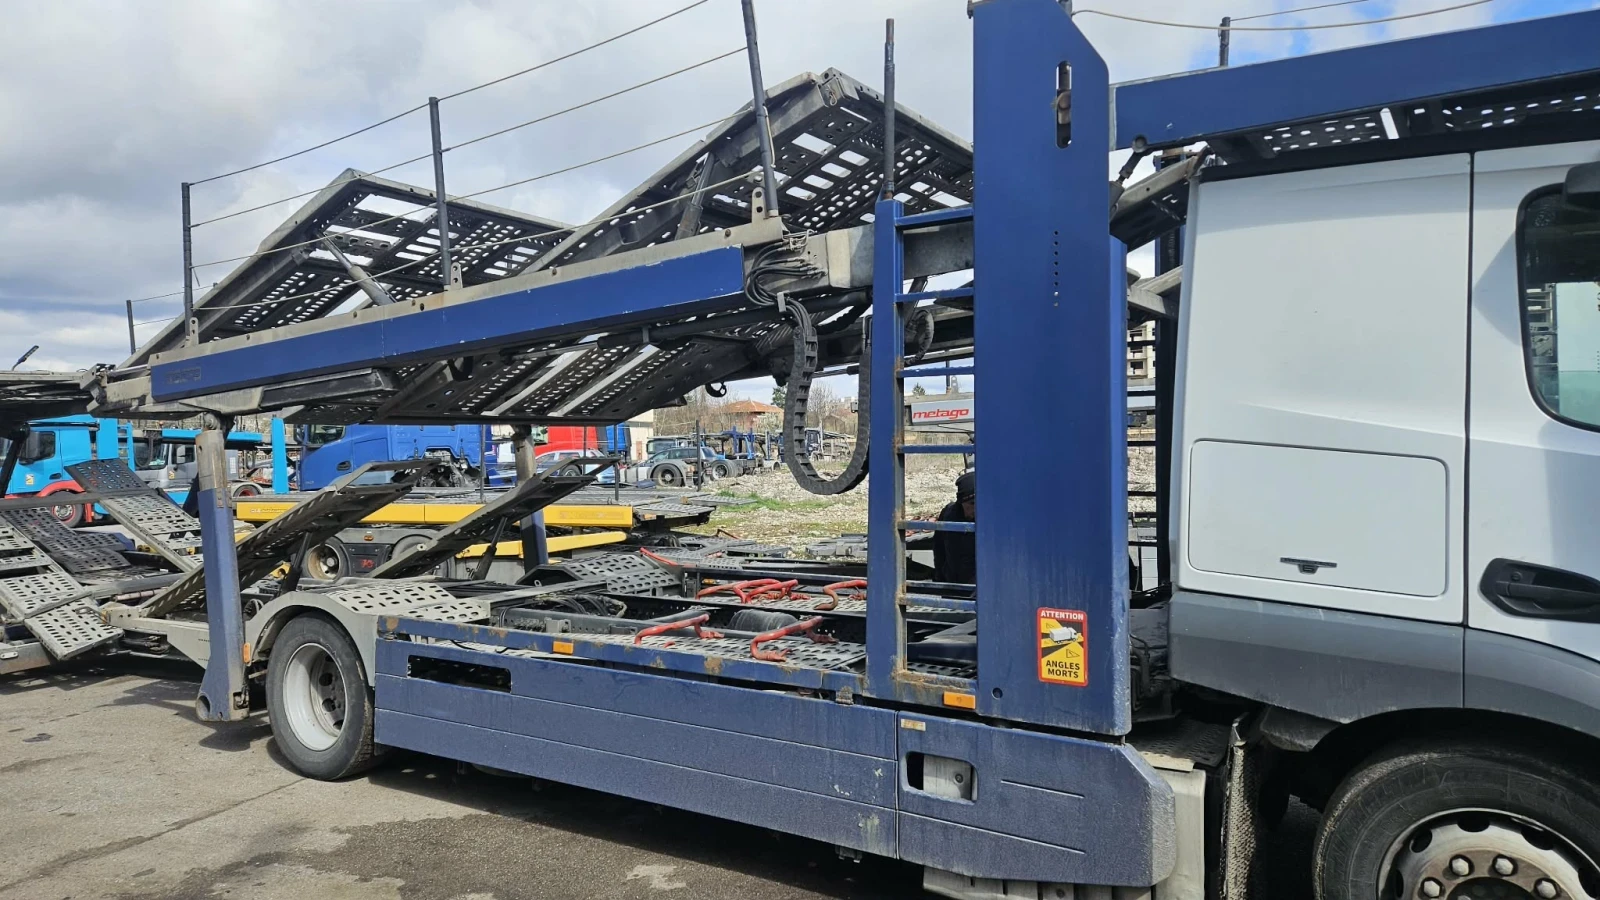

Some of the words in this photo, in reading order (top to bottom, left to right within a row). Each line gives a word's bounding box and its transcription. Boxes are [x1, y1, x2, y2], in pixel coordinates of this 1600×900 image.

[913, 408, 969, 420] metago
[1041, 610, 1083, 620] ATTENTION
[1046, 660, 1080, 670] ANGLES
[1048, 669, 1079, 678] MORTS
